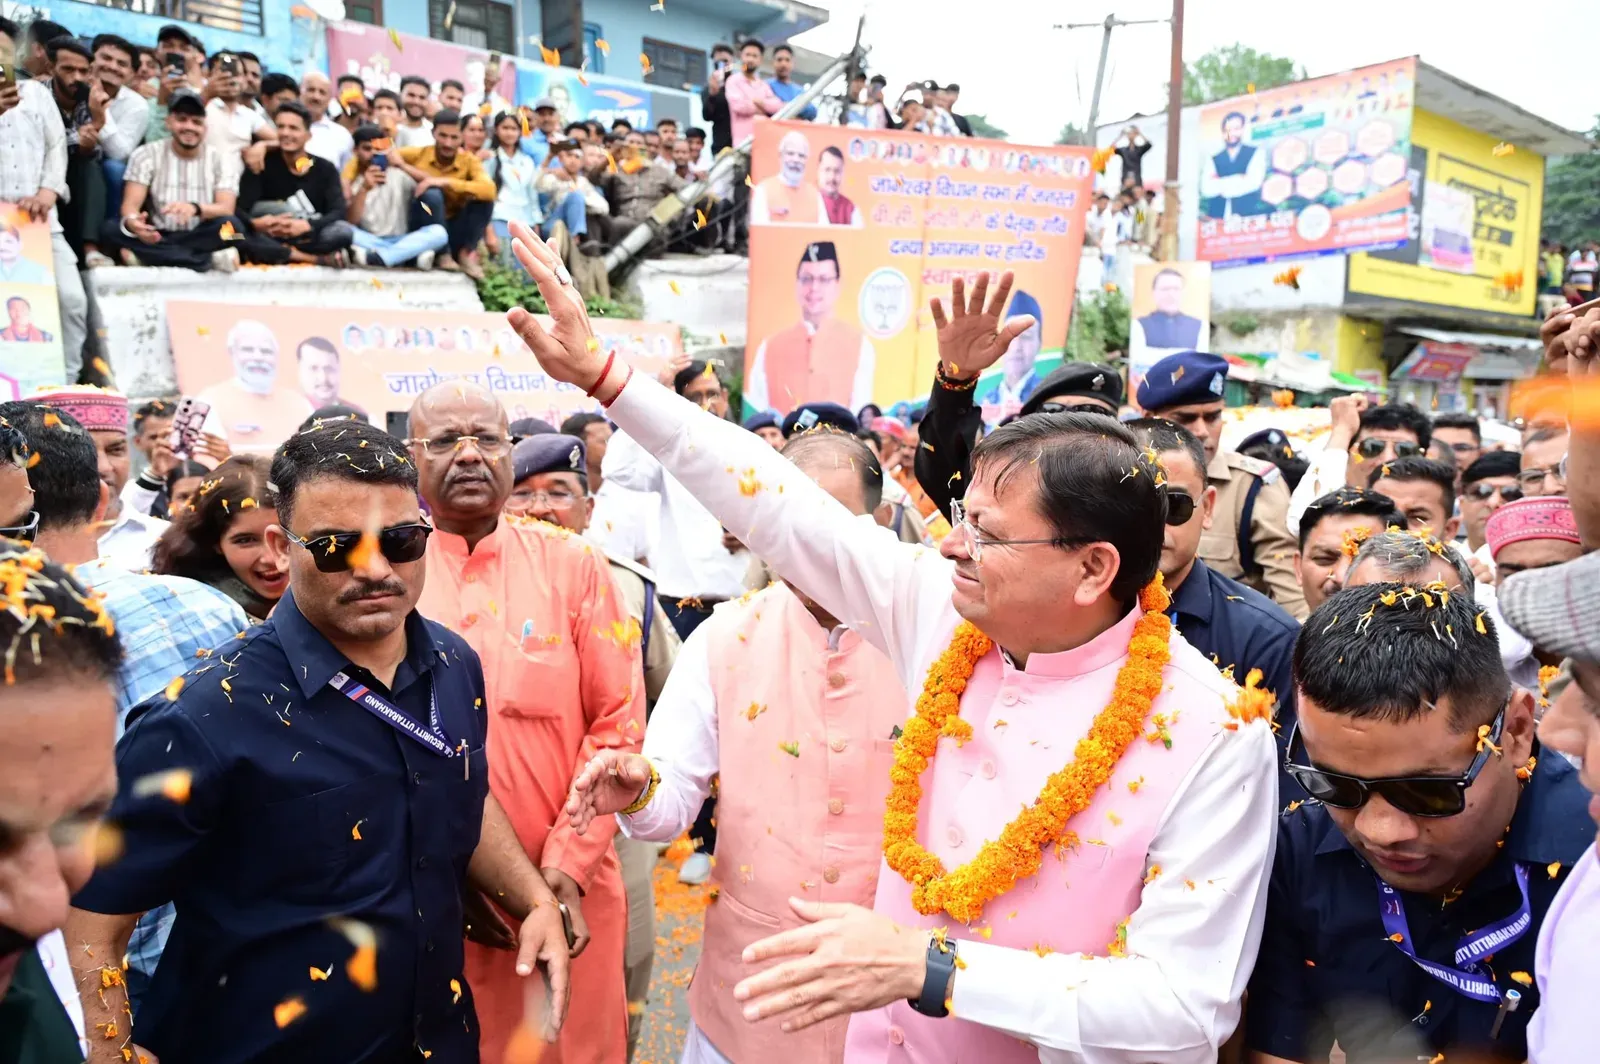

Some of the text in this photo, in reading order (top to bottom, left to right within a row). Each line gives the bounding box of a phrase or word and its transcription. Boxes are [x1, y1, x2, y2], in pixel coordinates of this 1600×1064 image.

[936, 174, 978, 197] विधान
[928, 241, 980, 257] आगमन
[985, 243, 1002, 258] पर
[487, 366, 547, 393] विधान
[364, 694, 416, 731] UTTARAKHAND
[413, 727, 446, 751] SECURITY
[1469, 912, 1530, 955] UTTARAKHAND
